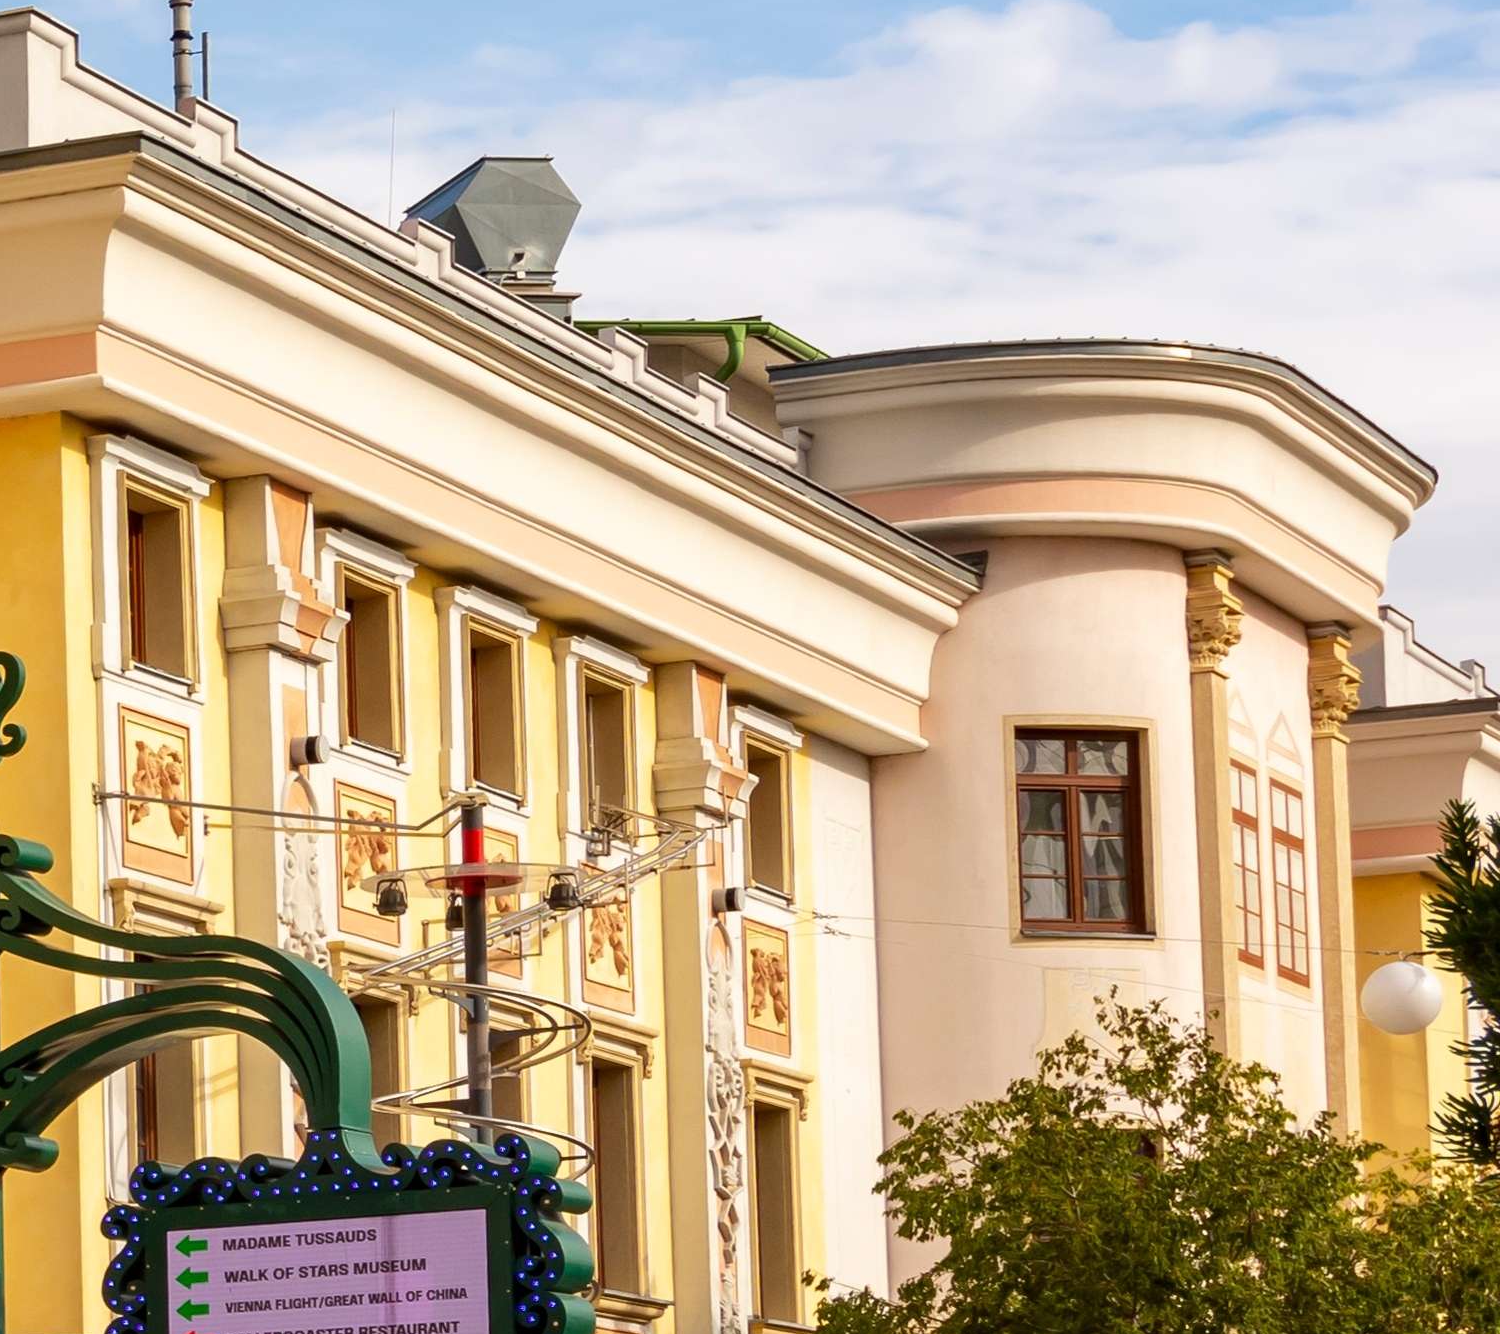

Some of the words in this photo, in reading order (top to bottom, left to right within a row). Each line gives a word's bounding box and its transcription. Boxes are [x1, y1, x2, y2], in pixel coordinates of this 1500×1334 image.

[222, 1234, 291, 1251] MADAME
[296, 1229, 377, 1247] TUSSAUDS
[224, 1269, 268, 1284] WALK
[273, 1267, 294, 1280] OF
[299, 1262, 349, 1279] STARS
[353, 1258, 427, 1275] MUSEUM
[225, 1299, 272, 1314] VIENNA
[275, 1294, 364, 1311] FLIGHT/GREAT
[368, 1291, 402, 1305] WALL
[405, 1290, 423, 1302] OF
[426, 1287, 468, 1301] CHINA
